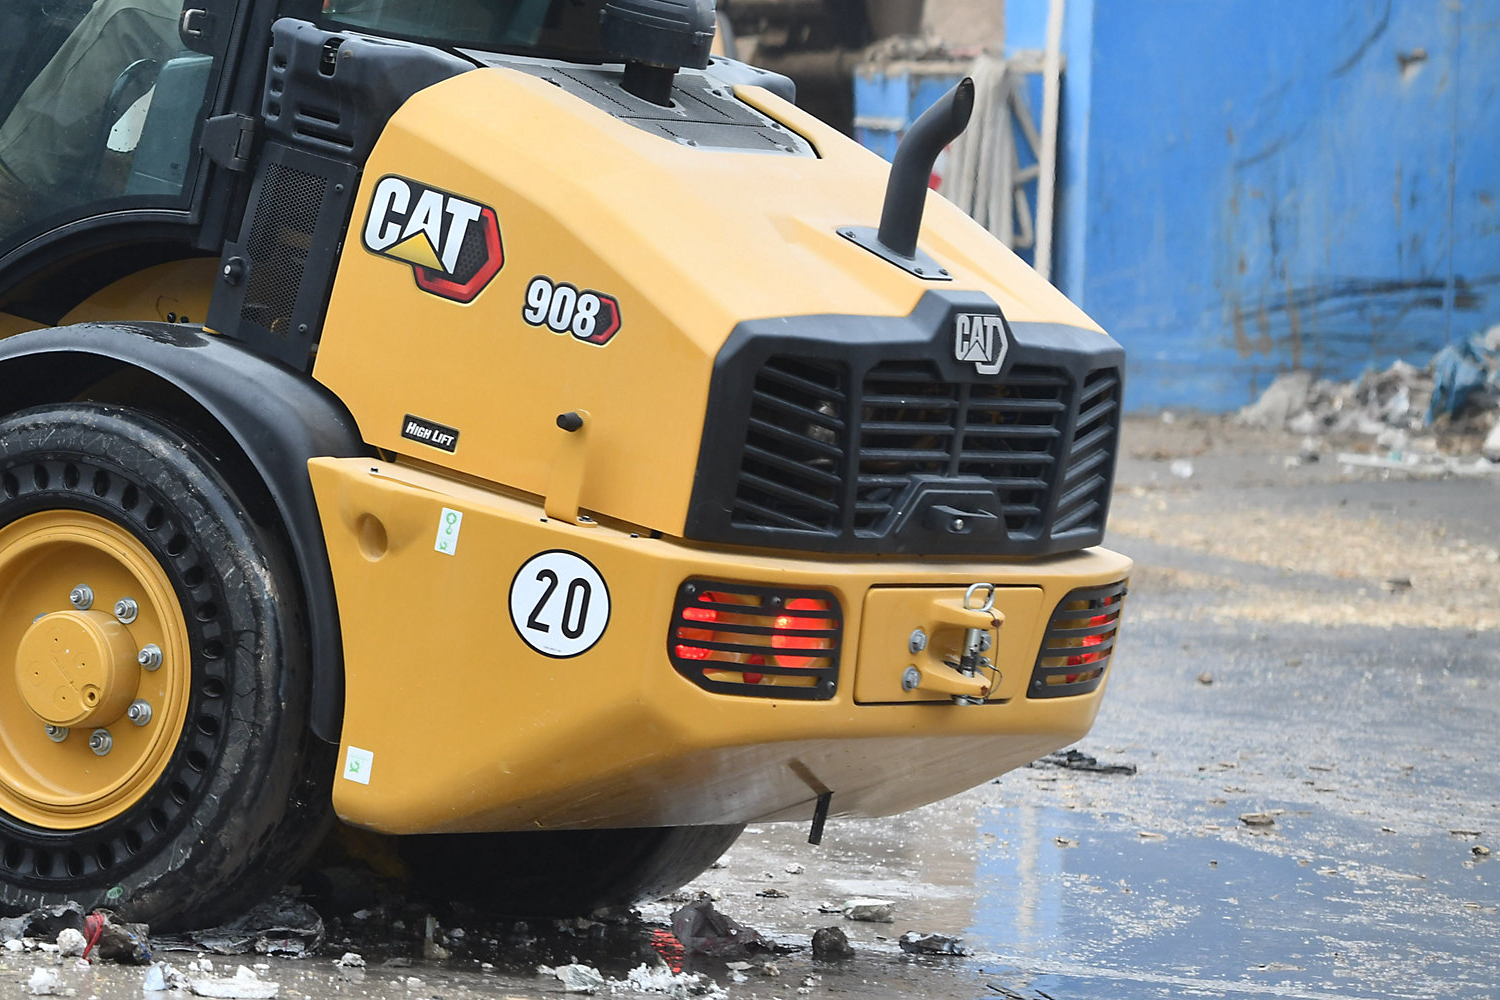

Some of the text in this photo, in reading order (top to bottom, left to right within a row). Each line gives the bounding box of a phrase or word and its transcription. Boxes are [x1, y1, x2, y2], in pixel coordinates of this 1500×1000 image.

[365, 177, 482, 274] CAT
[524, 279, 601, 338] 908
[955, 313, 1002, 362] CAT
[405, 421, 455, 446] HIGH LIFT
[526, 568, 592, 640] 20
